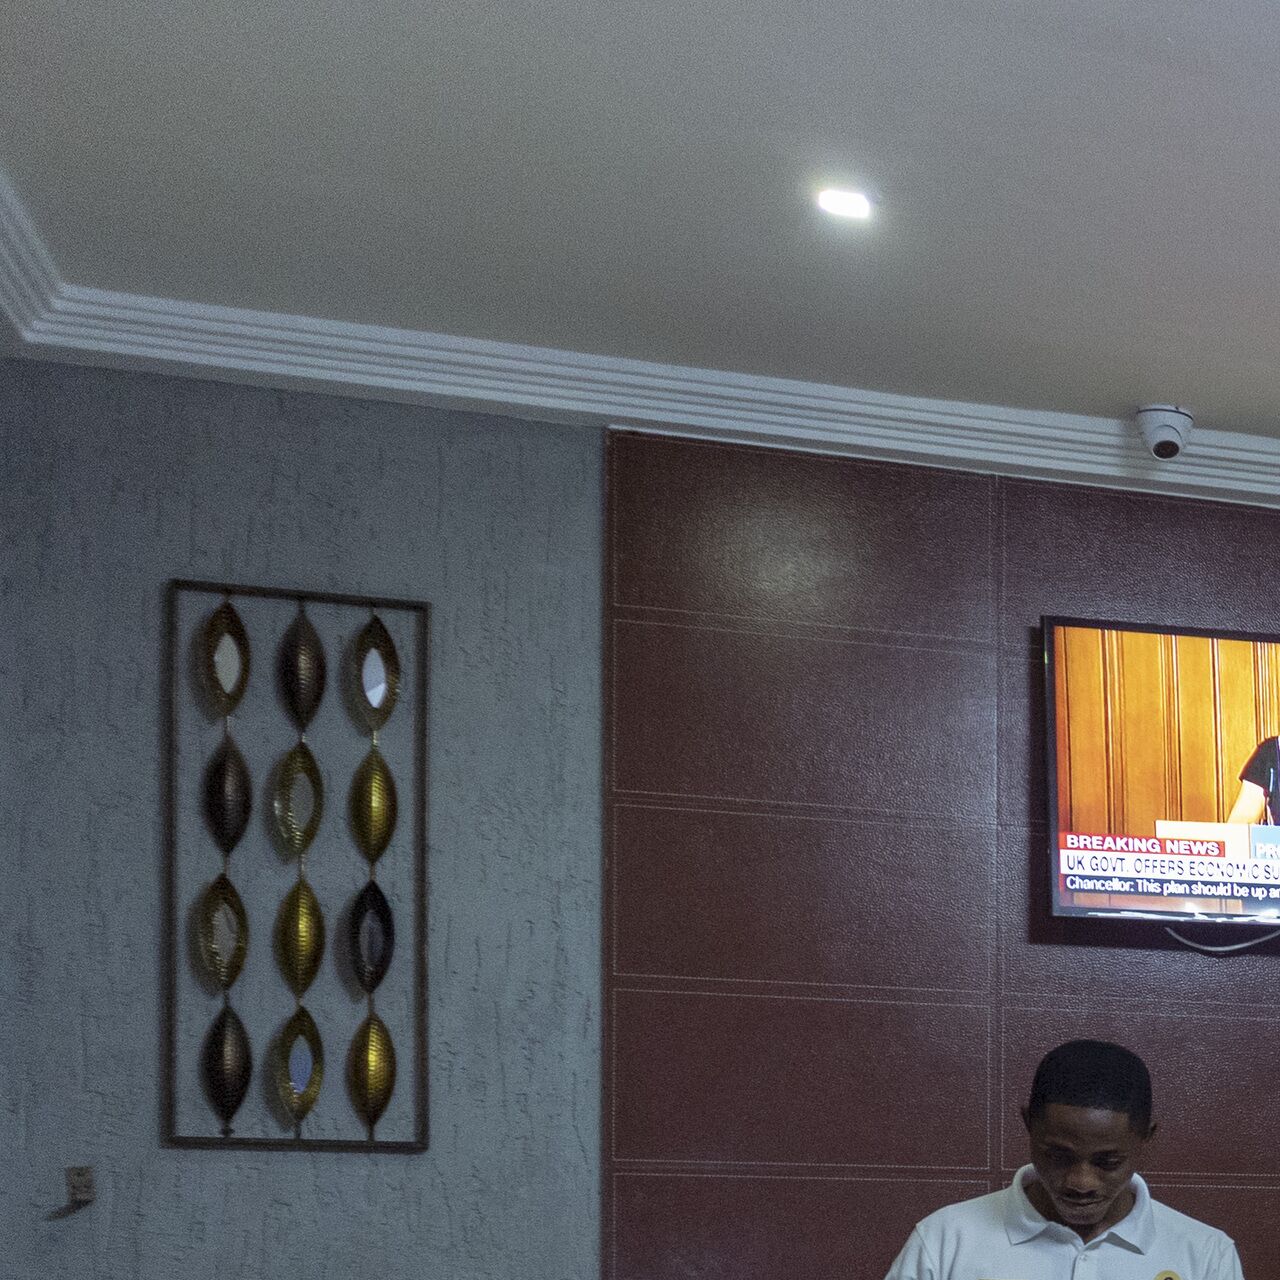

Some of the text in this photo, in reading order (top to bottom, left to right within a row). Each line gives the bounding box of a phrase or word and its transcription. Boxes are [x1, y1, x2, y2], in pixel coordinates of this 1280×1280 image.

[1066, 834, 1220, 856] BREAKING NEWS
[1066, 854, 1085, 871] UK
[1089, 855, 1129, 872] GOVT.
[1133, 857, 1184, 876] OFFERS
[1065, 875, 1135, 892] Chancellor:
[1136, 878, 1162, 893] This
[1162, 880, 1190, 897] plan
[1190, 881, 1232, 896] should
[1233, 884, 1250, 897] be
[1250, 887, 1268, 900] up
